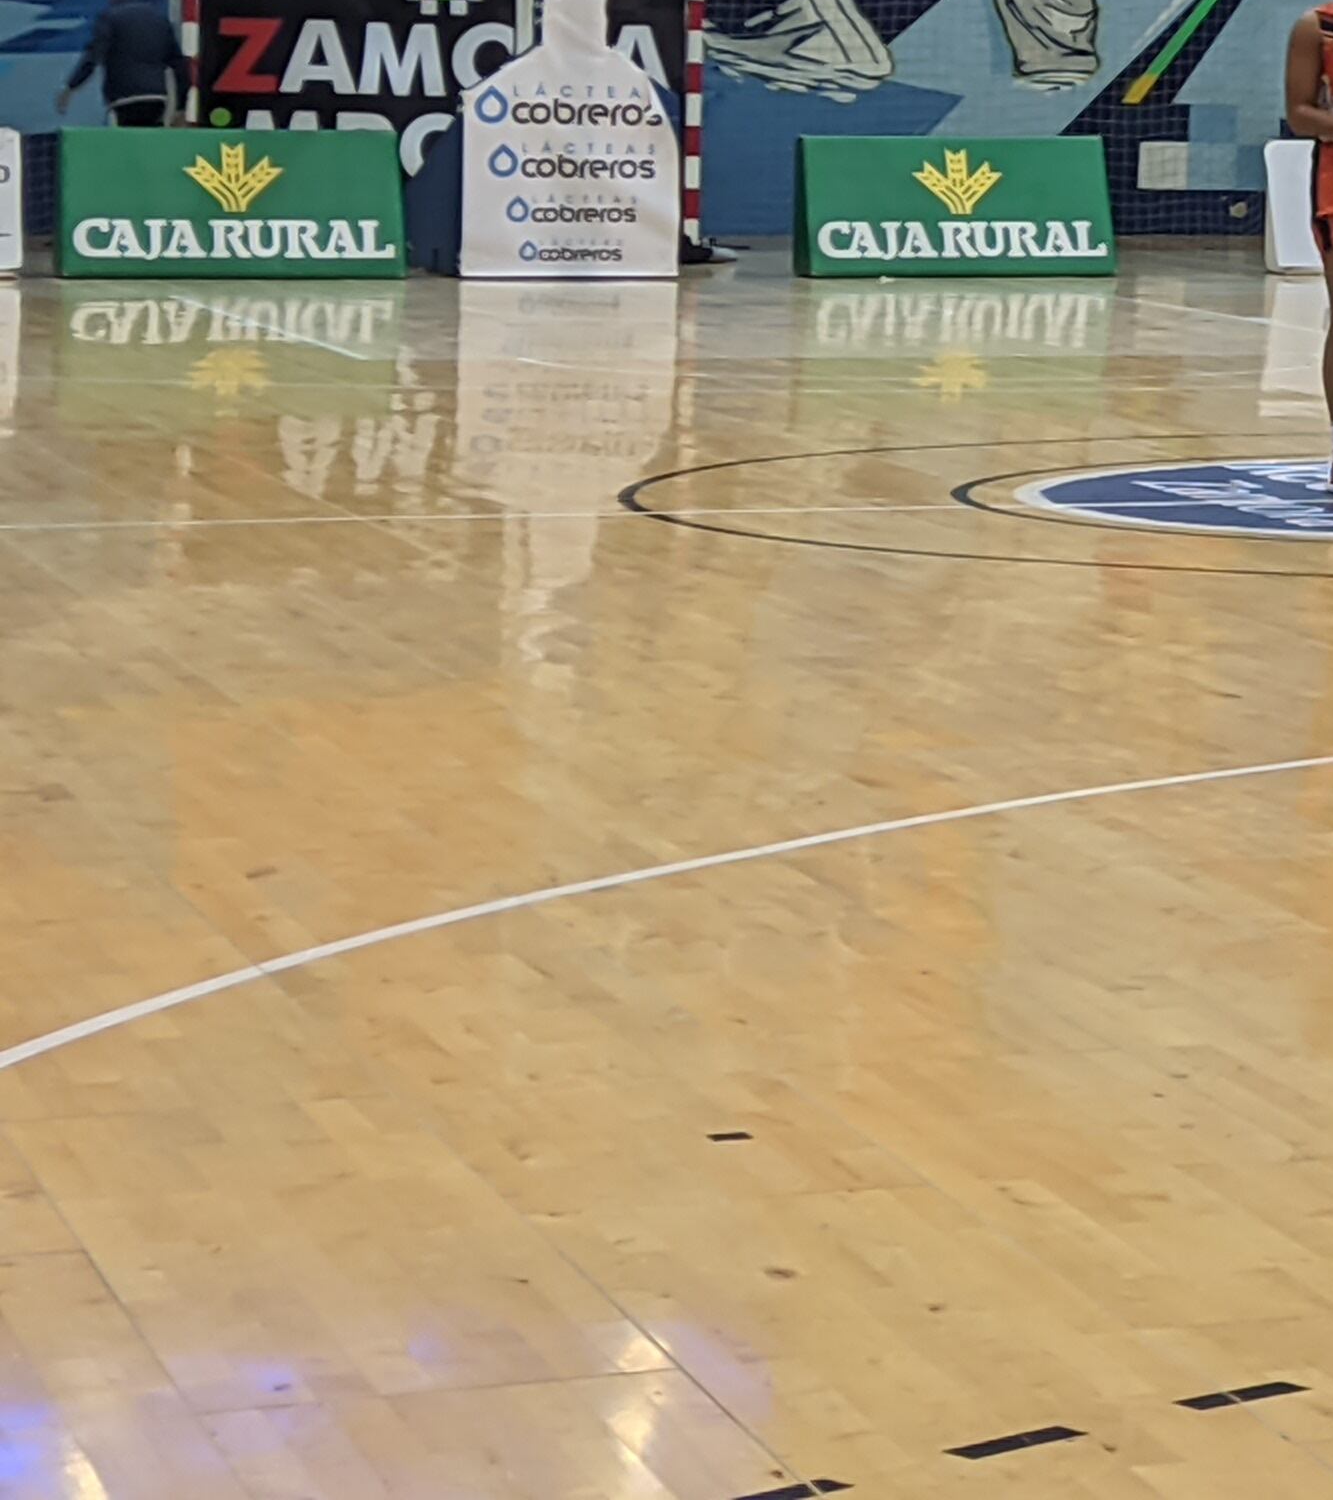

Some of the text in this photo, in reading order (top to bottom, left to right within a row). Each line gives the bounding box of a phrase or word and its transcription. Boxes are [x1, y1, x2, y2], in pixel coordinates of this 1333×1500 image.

[213, 18, 670, 96] ZAMOA
[511, 98, 663, 126] cobreros
[520, 154, 656, 179] cobreros
[530, 204, 637, 223] cobreros
[72, 217, 396, 260] CAJA RURAL
[816, 220, 1107, 259] CAJA RURAL
[537, 248, 623, 262] cobreros
